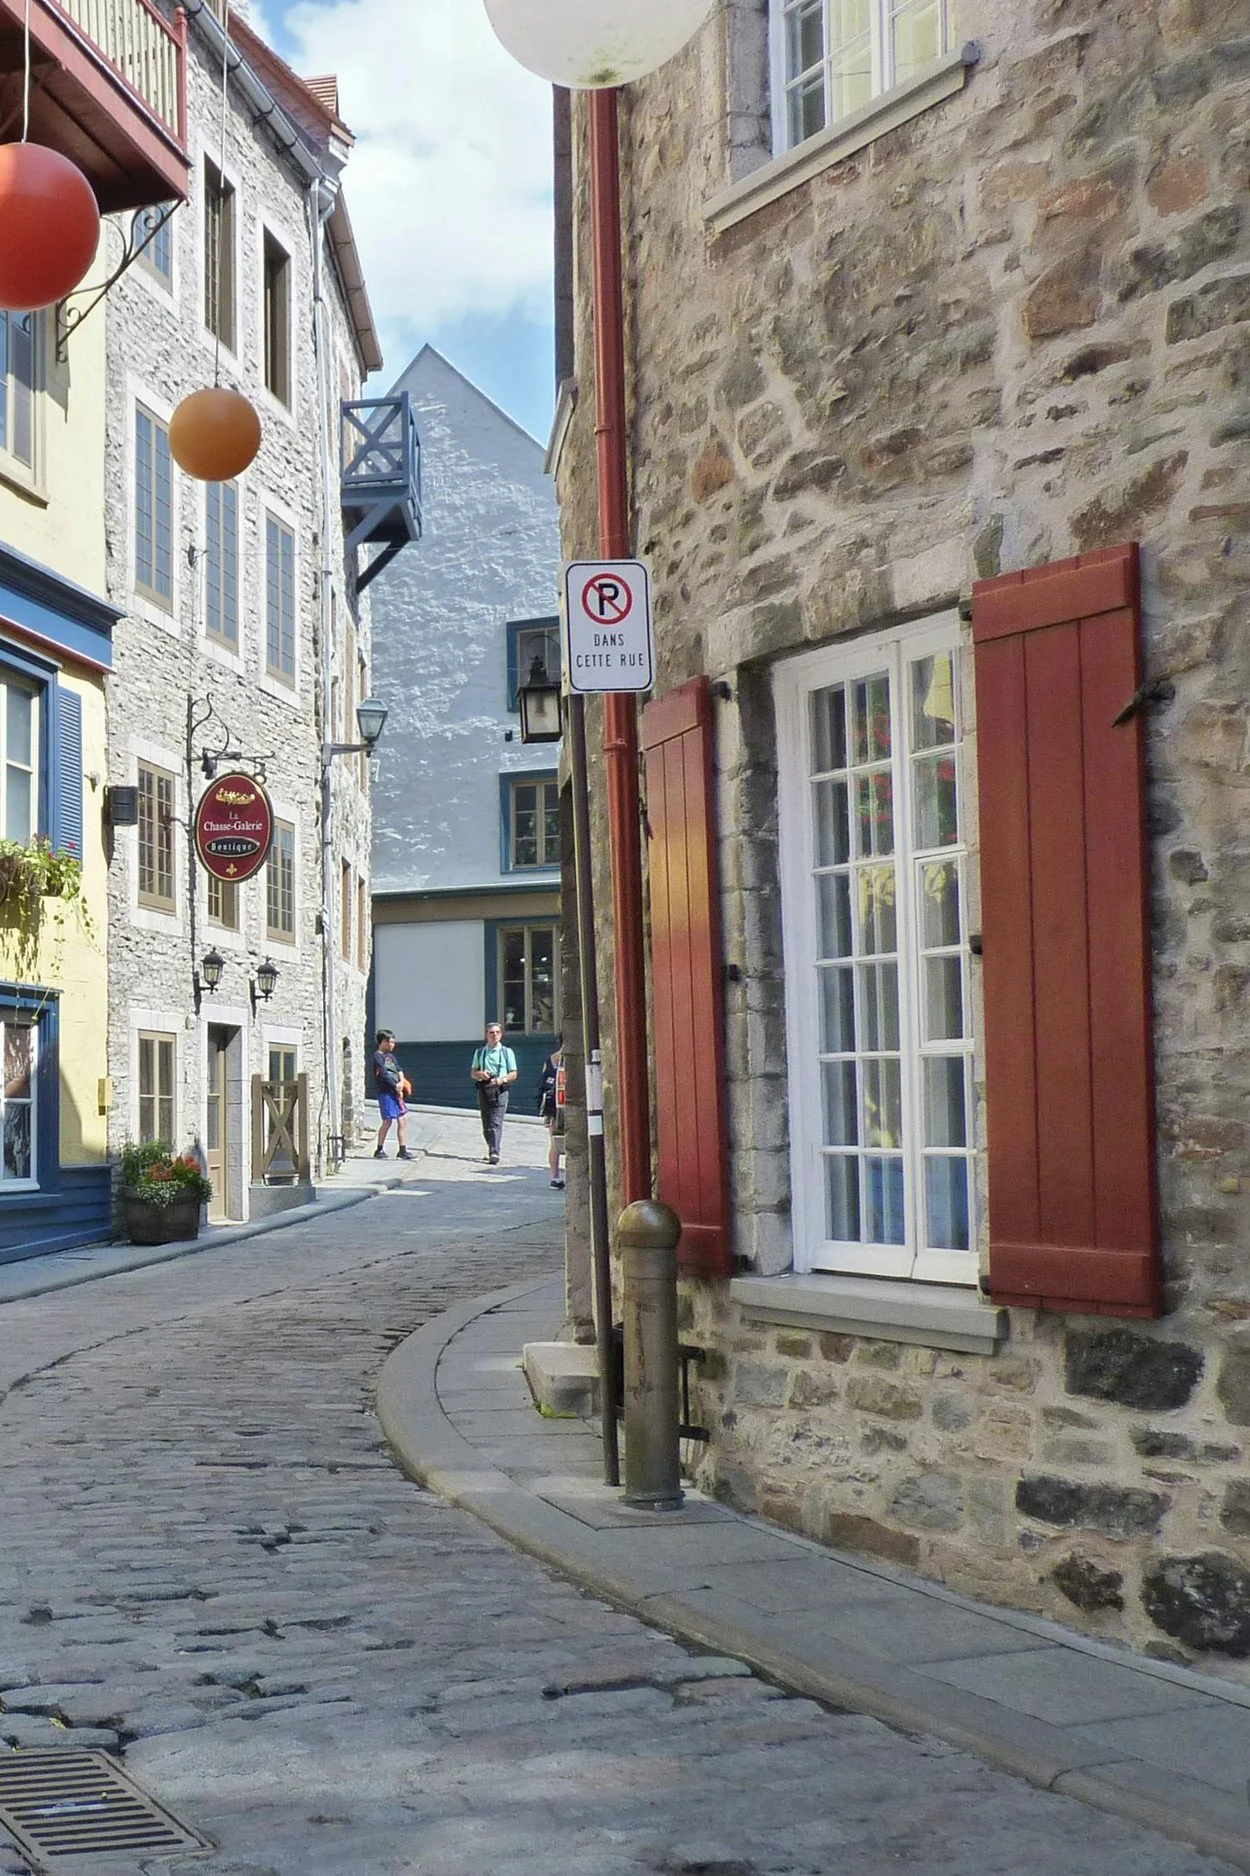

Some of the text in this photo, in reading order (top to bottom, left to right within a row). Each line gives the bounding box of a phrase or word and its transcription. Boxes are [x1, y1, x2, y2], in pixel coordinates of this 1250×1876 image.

[593, 633, 625, 647] DANS
[576, 653, 644, 668] CETTE RUE
[203, 820, 263, 832] Chasse-Galerie
